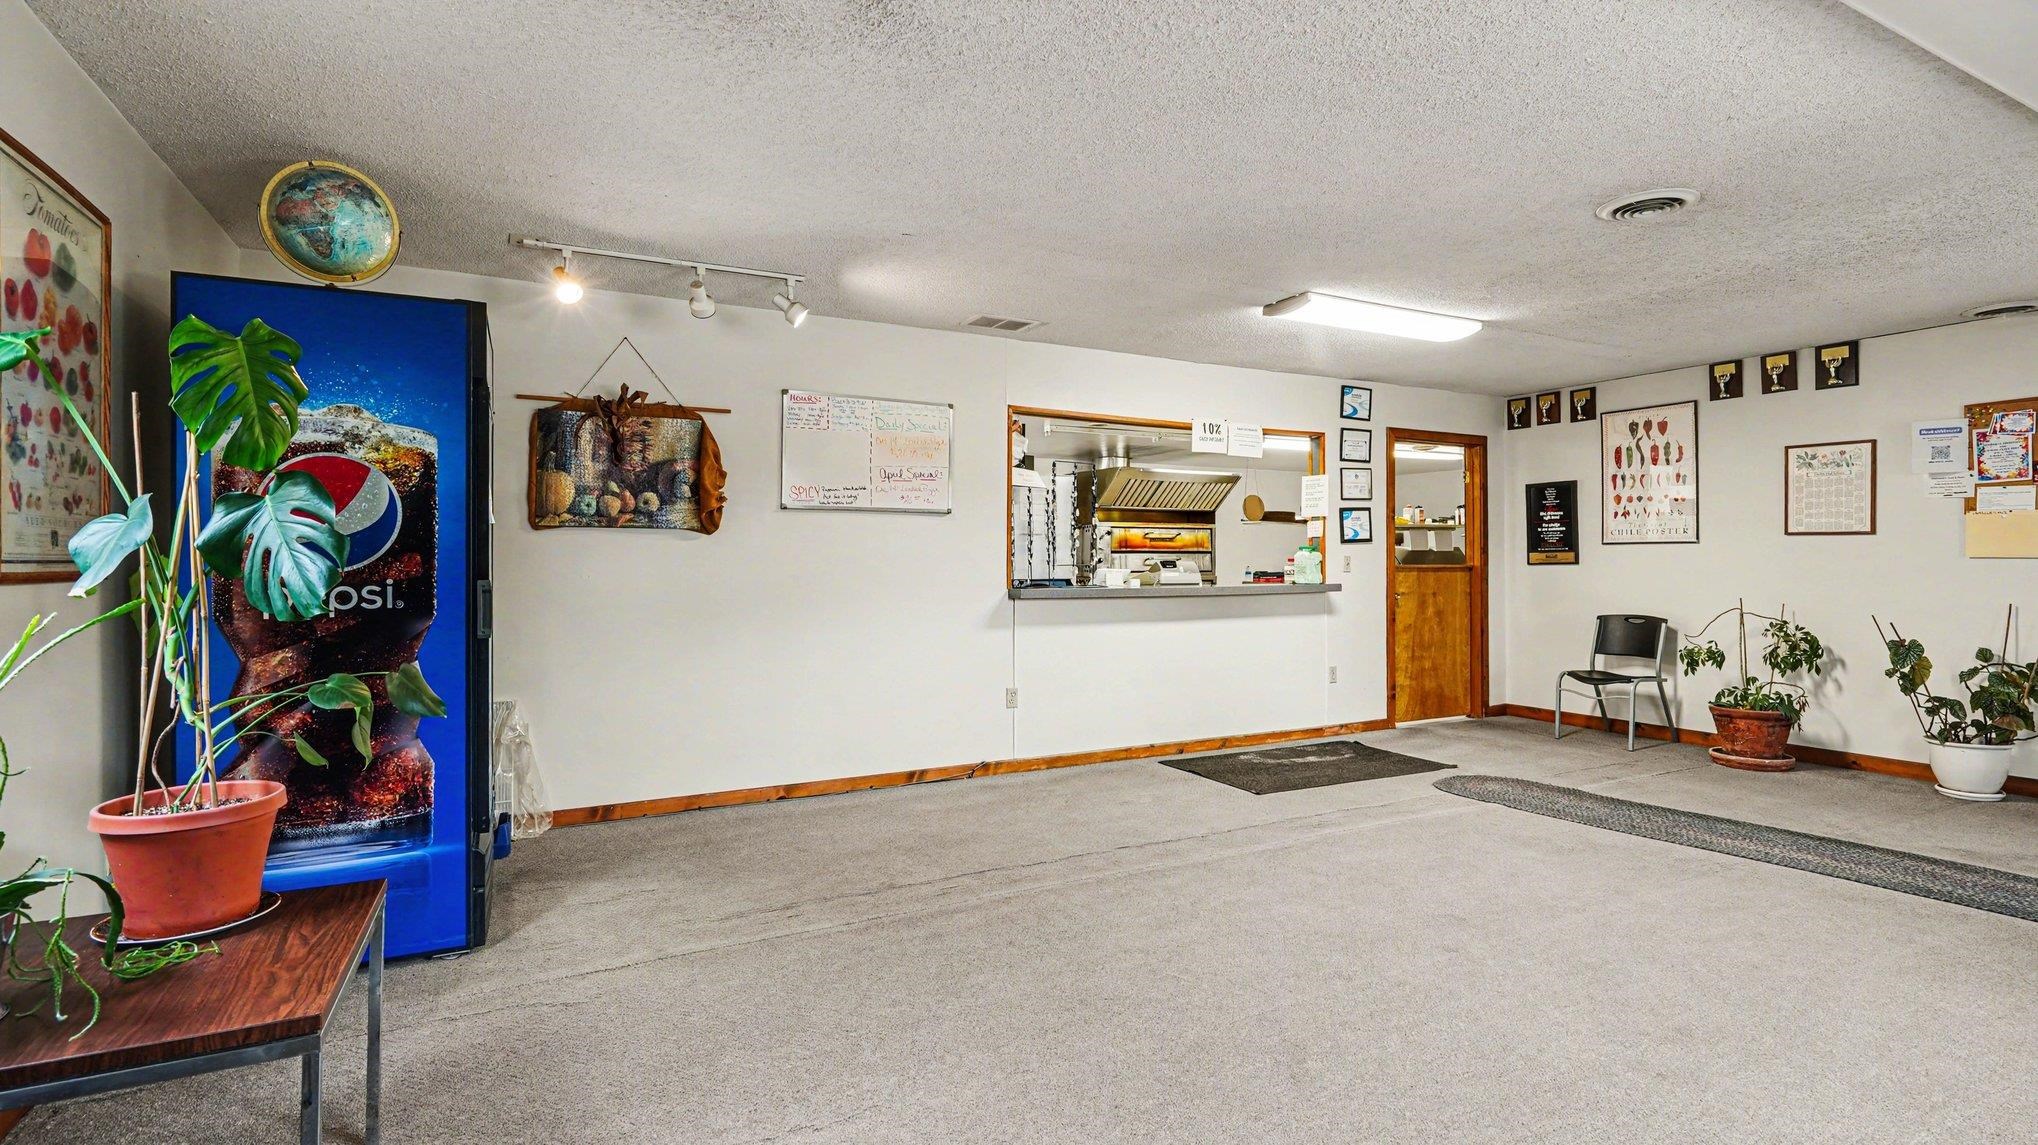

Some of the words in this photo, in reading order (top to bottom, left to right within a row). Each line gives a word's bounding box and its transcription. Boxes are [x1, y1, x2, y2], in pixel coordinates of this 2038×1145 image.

[23, 179, 80, 246] Tomatoes
[875, 416, 904, 431] Daily
[1203, 422, 1222, 435] 10%
[789, 485, 821, 499] SPICY
[1610, 528, 1642, 536] CHILE
